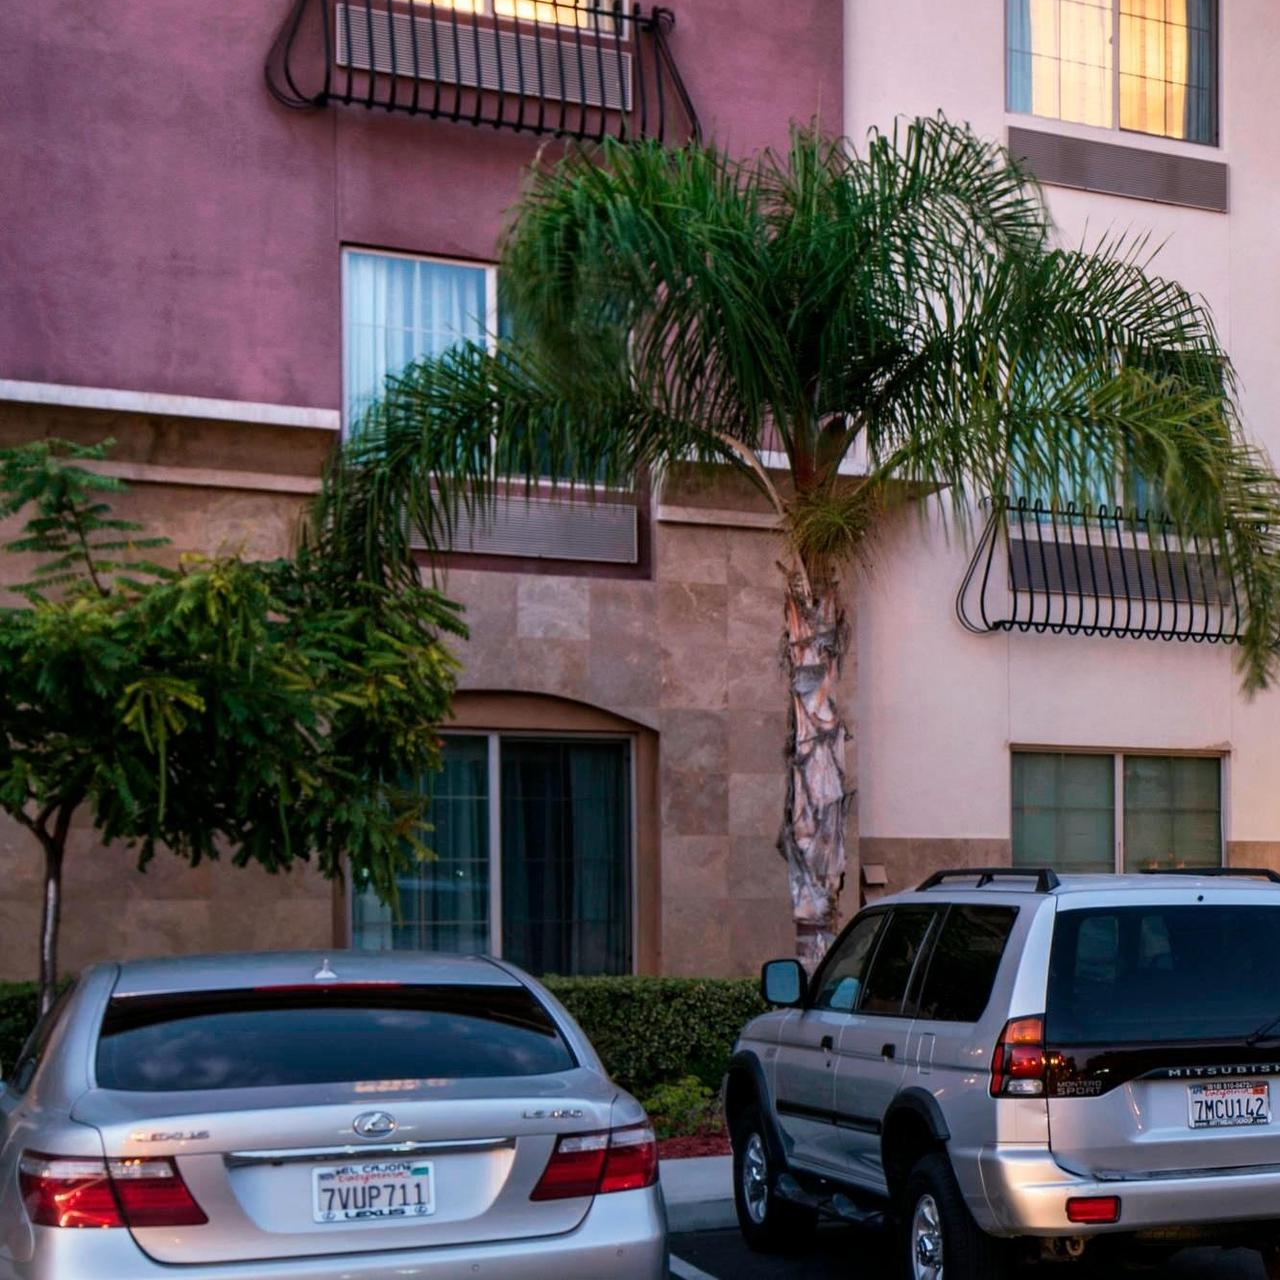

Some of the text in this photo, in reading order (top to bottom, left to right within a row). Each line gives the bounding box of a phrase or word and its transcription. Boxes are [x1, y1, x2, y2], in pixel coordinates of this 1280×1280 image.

[1056, 1086, 1101, 1096] SPORT
[1194, 1097, 1265, 1121] 7MCU142
[321, 1181, 426, 1212] 7VUP711
[344, 1207, 406, 1219] LEXUS
